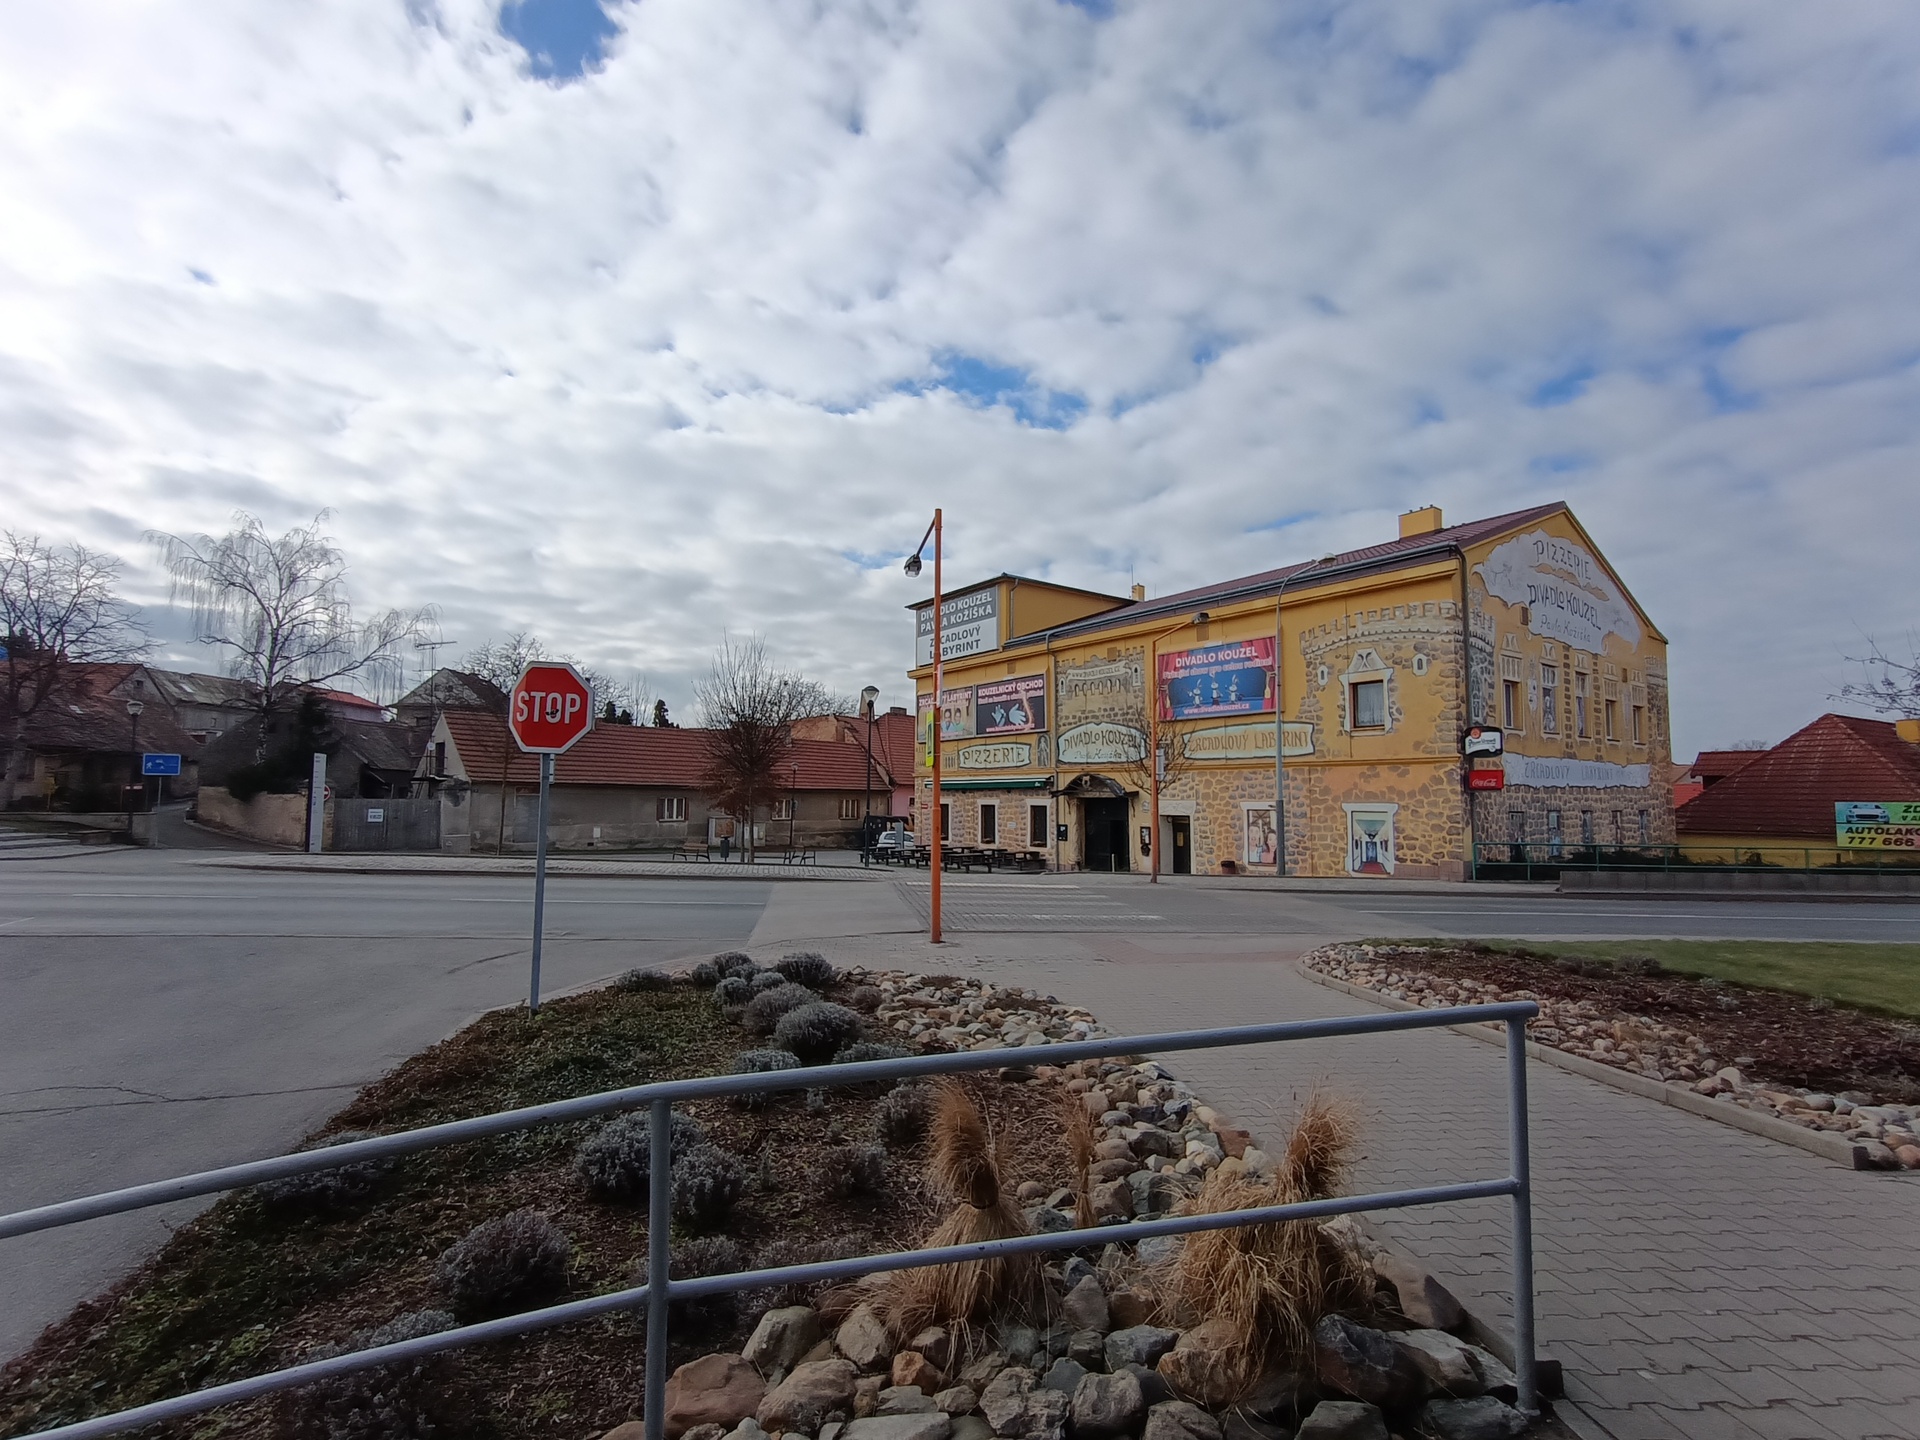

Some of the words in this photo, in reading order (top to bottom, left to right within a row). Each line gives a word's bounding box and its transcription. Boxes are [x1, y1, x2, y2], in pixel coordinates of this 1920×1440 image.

[1533, 540, 1591, 580] PIZZERIE
[921, 602, 956, 621] DIVDLO
[958, 592, 992, 611] KOUZEL
[1527, 584, 1564, 610] DIVADLO
[1566, 591, 1601, 630] KOUZEL
[921, 617, 948, 633] PAVA
[950, 604, 992, 624] KOŽÍŠKA
[930, 624, 981, 647] ZCADLOVÝ
[930, 639, 981, 659] LBYRINT
[1175, 652, 1216, 667] DIVADLO
[1218, 646, 1258, 661] KOUZEL
[1017, 679, 1044, 692] OBCHOD
[516, 690, 581, 724] STOP
[1062, 731, 1099, 755] DIVADLO
[1254, 731, 1309, 749] LABRINT
[962, 746, 1025, 765] PIZZERIE
[1847, 837, 1877, 845] 777
[1882, 837, 1915, 847] 666
